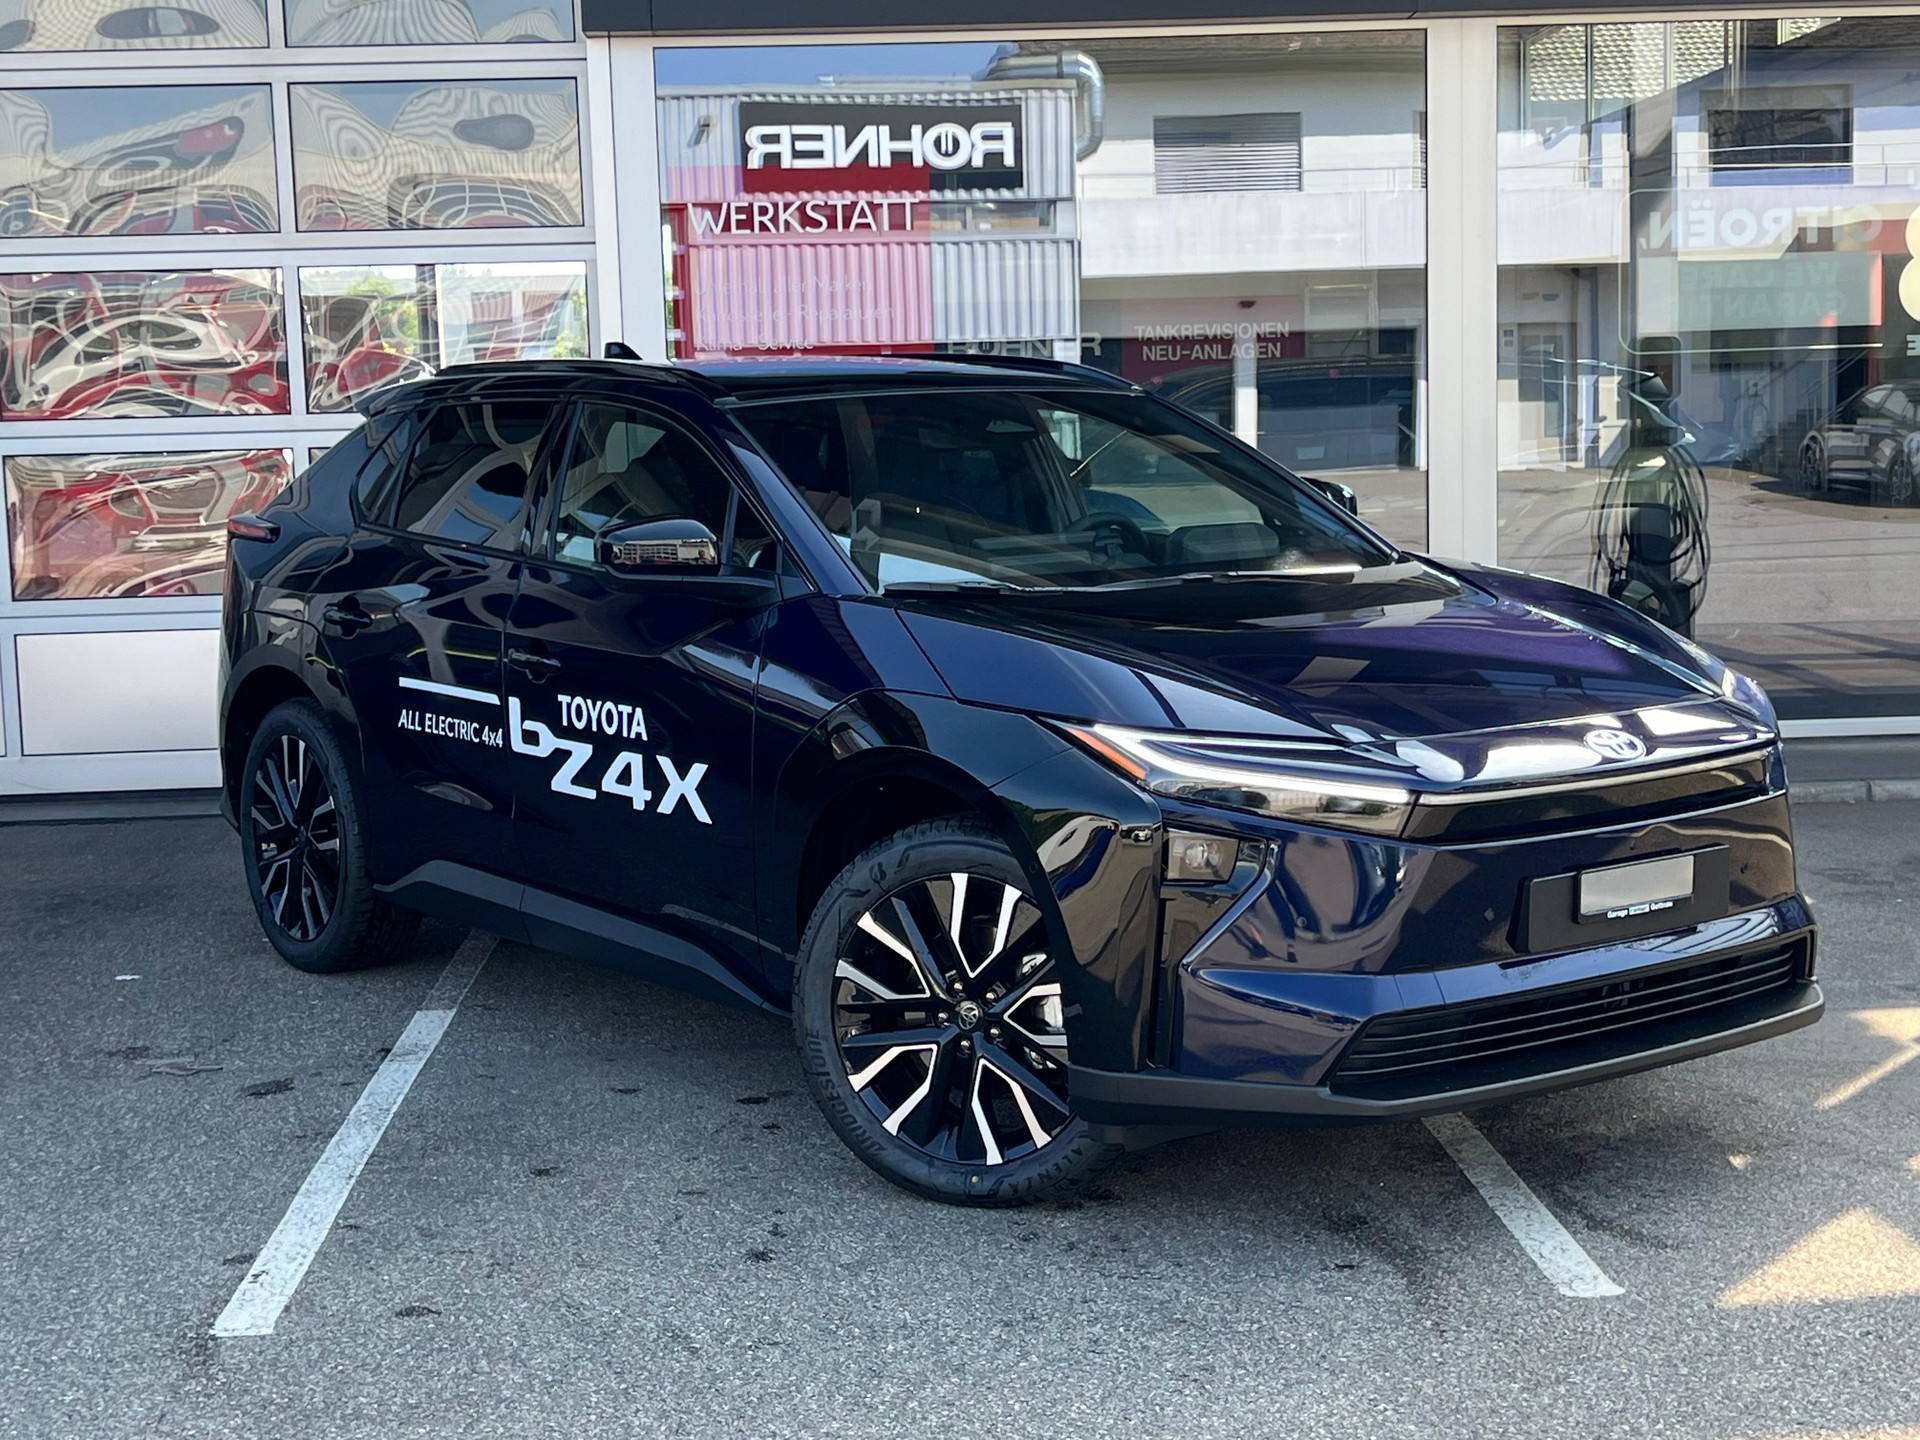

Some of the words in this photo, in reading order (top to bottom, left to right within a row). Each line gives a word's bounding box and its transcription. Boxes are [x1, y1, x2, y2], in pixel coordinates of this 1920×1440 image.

[687, 198, 920, 235] WERKSTATT
[1134, 322, 1291, 342] TANKREVISIONEN
[1142, 342, 1281, 363] NEU-ANLAGEN
[398, 708, 423, 732] ALL
[425, 713, 480, 743] ELECTRIC
[481, 728, 504, 749] 4x4
[557, 694, 648, 742] TOYOTA
